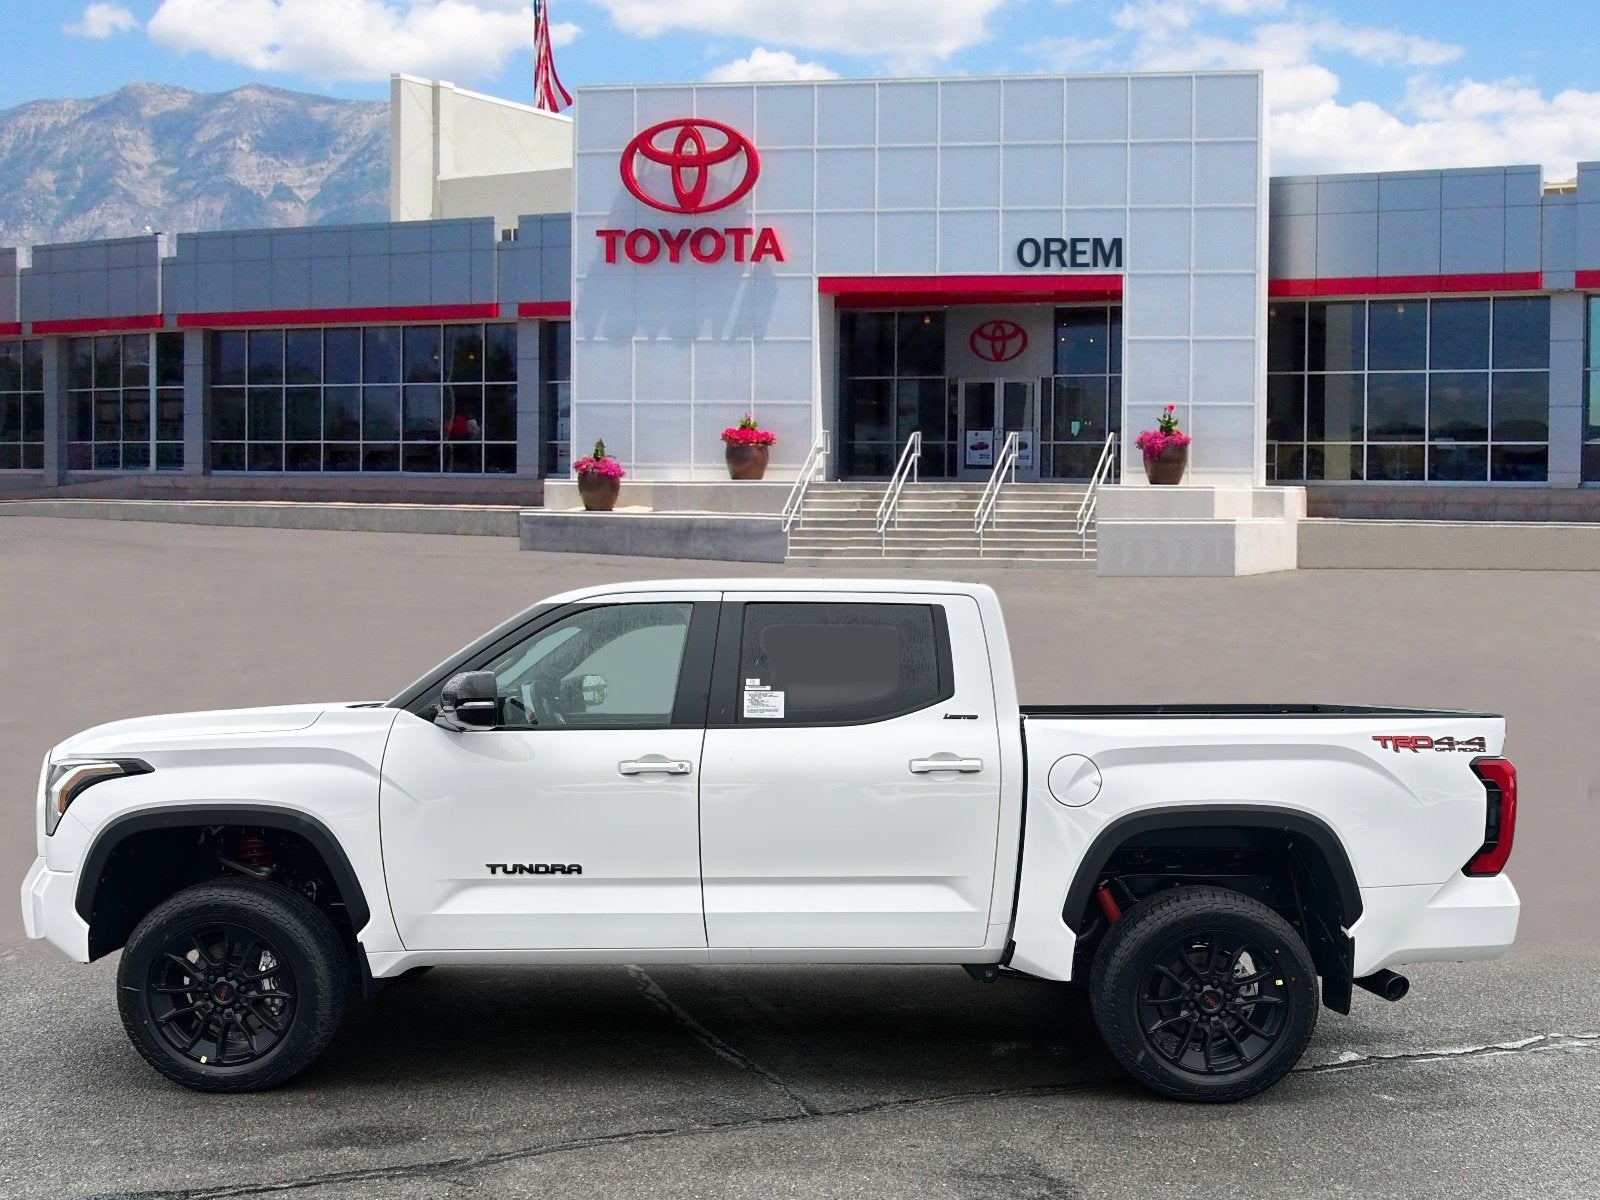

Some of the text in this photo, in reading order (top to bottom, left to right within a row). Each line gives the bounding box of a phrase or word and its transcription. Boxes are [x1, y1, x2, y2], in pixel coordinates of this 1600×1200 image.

[596, 227, 785, 264] TOYOTA
[1016, 237, 1123, 268] OREM
[1372, 735, 1434, 753] TRD
[485, 863, 583, 875] TUNDRA
